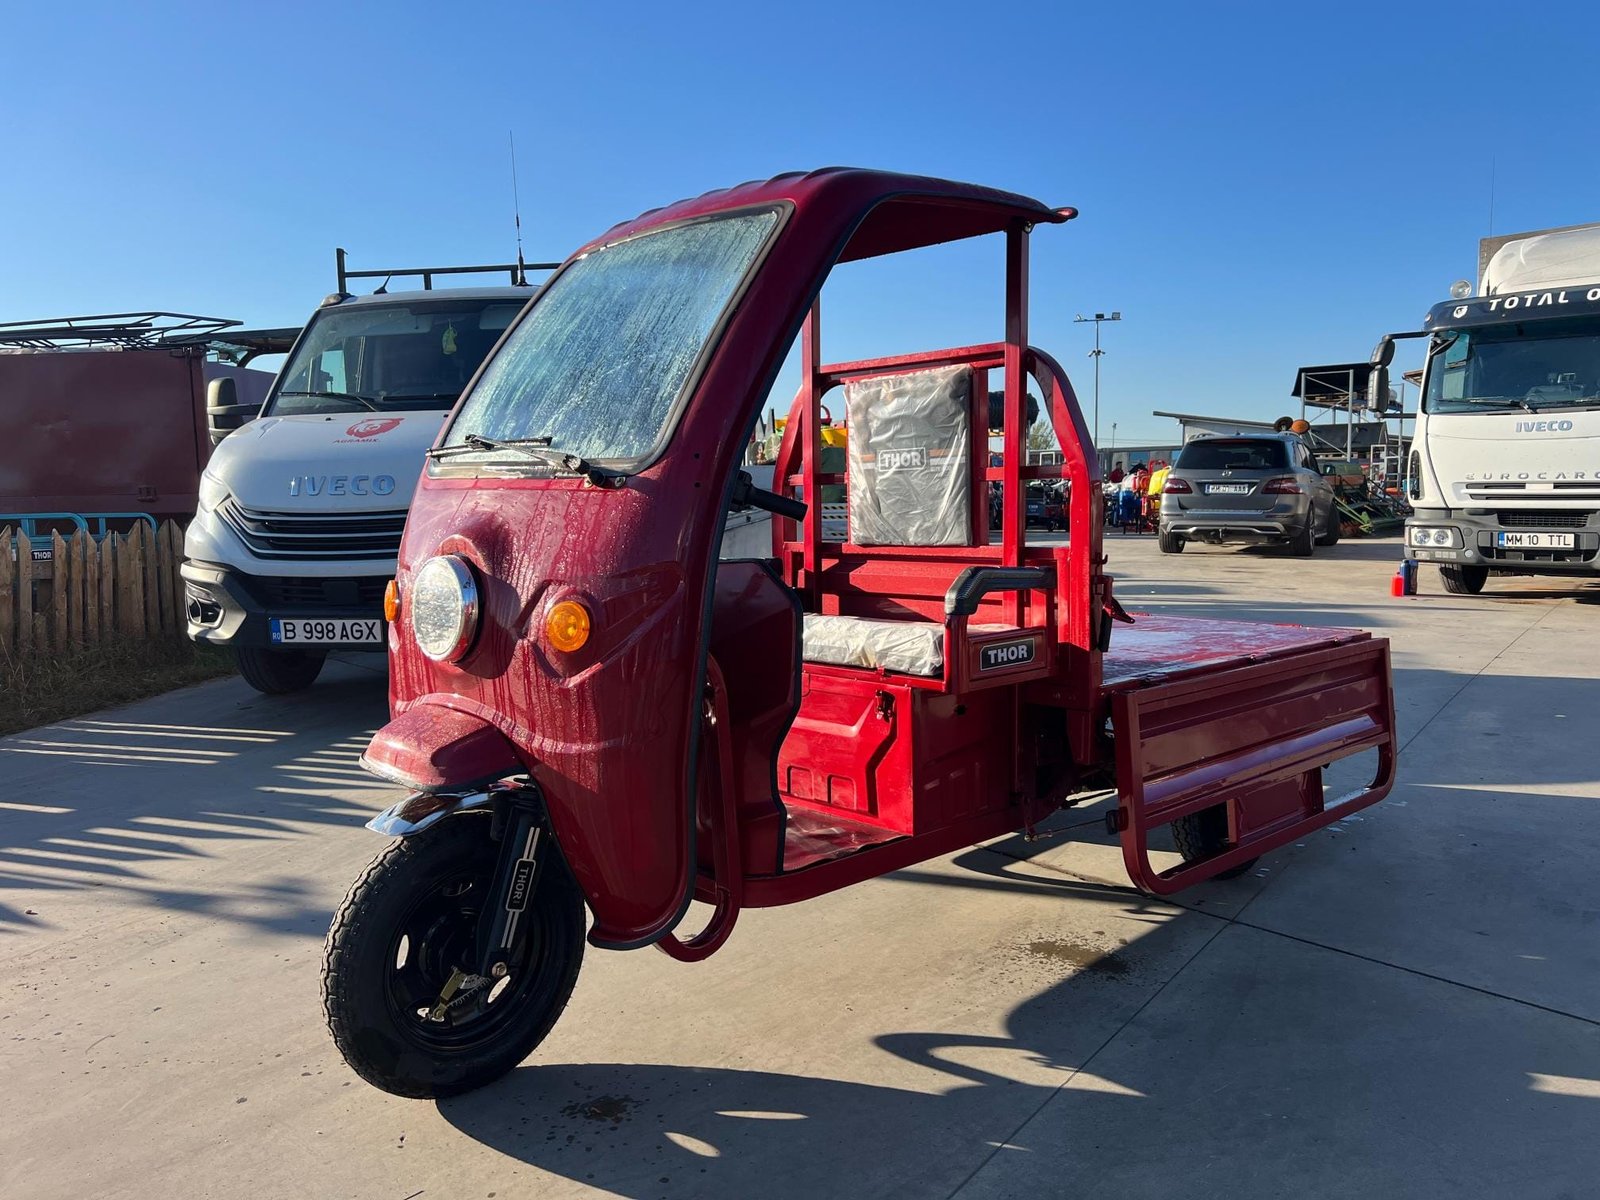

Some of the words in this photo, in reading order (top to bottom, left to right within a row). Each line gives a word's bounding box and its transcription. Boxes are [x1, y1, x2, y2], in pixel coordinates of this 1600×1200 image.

[1489, 291, 1569, 311] TOTAL
[1516, 420, 1573, 433] IVECO
[883, 451, 921, 468] THOR
[290, 474, 396, 497] IVECO
[1506, 534, 1523, 545] MM
[1527, 535, 1539, 545] 10
[1547, 535, 1571, 546] TTL
[33, 551, 52, 560] THOR
[272, 632, 281, 640] RO
[283, 621, 296, 640] B
[303, 621, 336, 640] 998
[340, 621, 377, 641] AGX
[987, 644, 1028, 664] THOR
